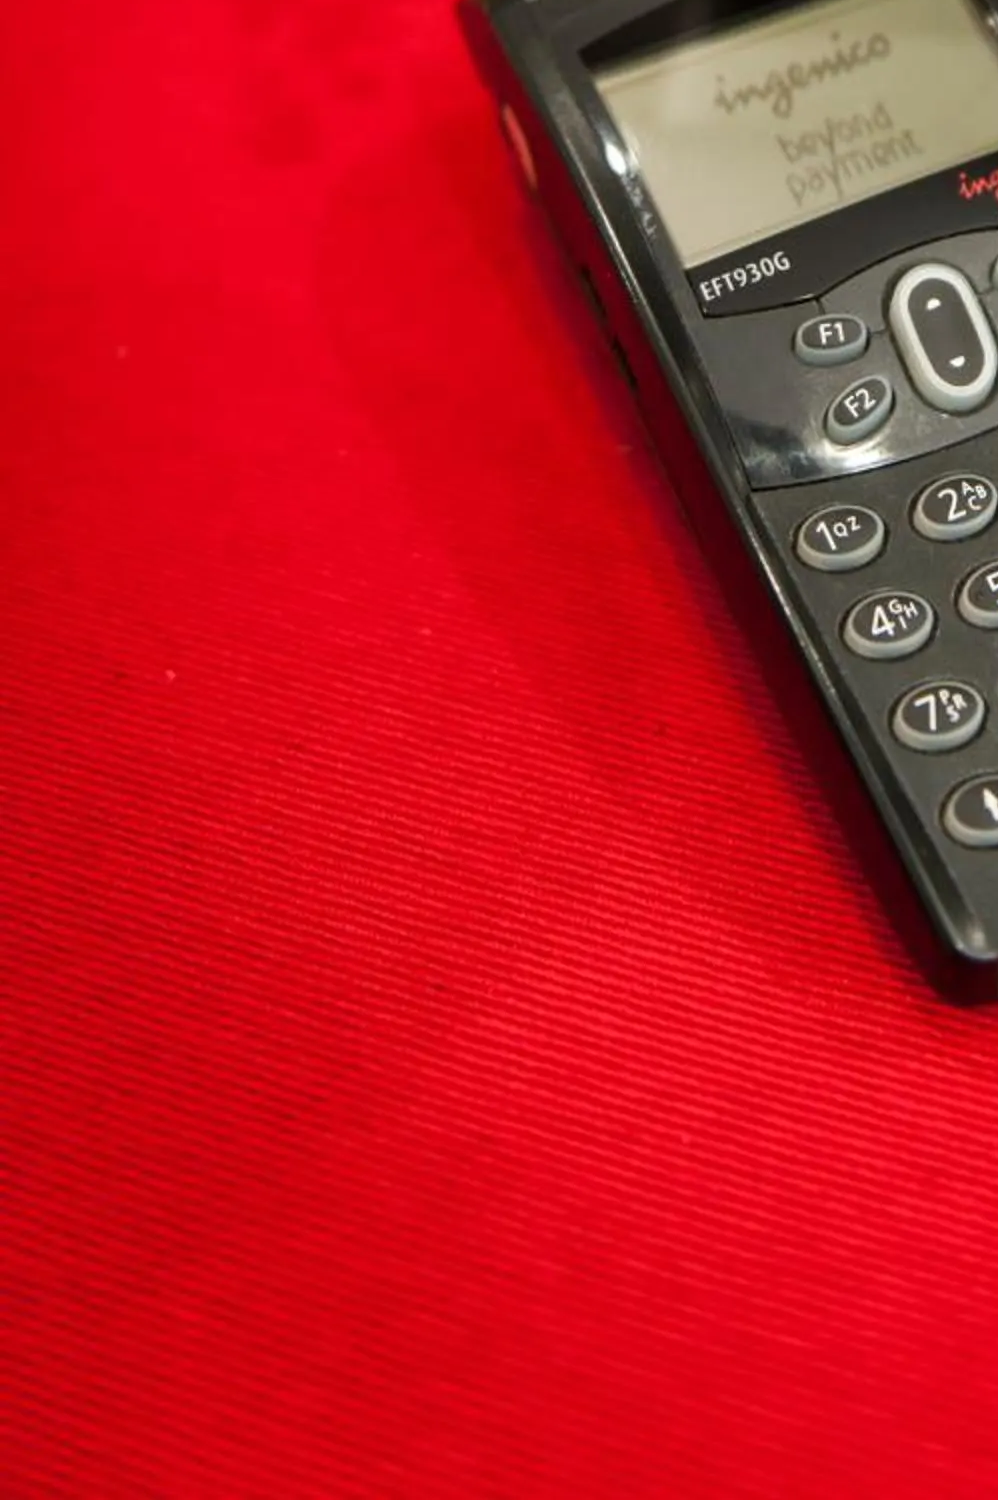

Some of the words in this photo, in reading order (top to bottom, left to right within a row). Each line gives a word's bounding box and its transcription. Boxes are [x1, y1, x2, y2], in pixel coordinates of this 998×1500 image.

[713, 30, 890, 120] ingenico
[776, 101, 893, 164] beyond
[784, 128, 923, 206] payment
[699, 251, 792, 302] EFT930G
[818, 322, 846, 345] F1
[843, 388, 877, 419] F2
